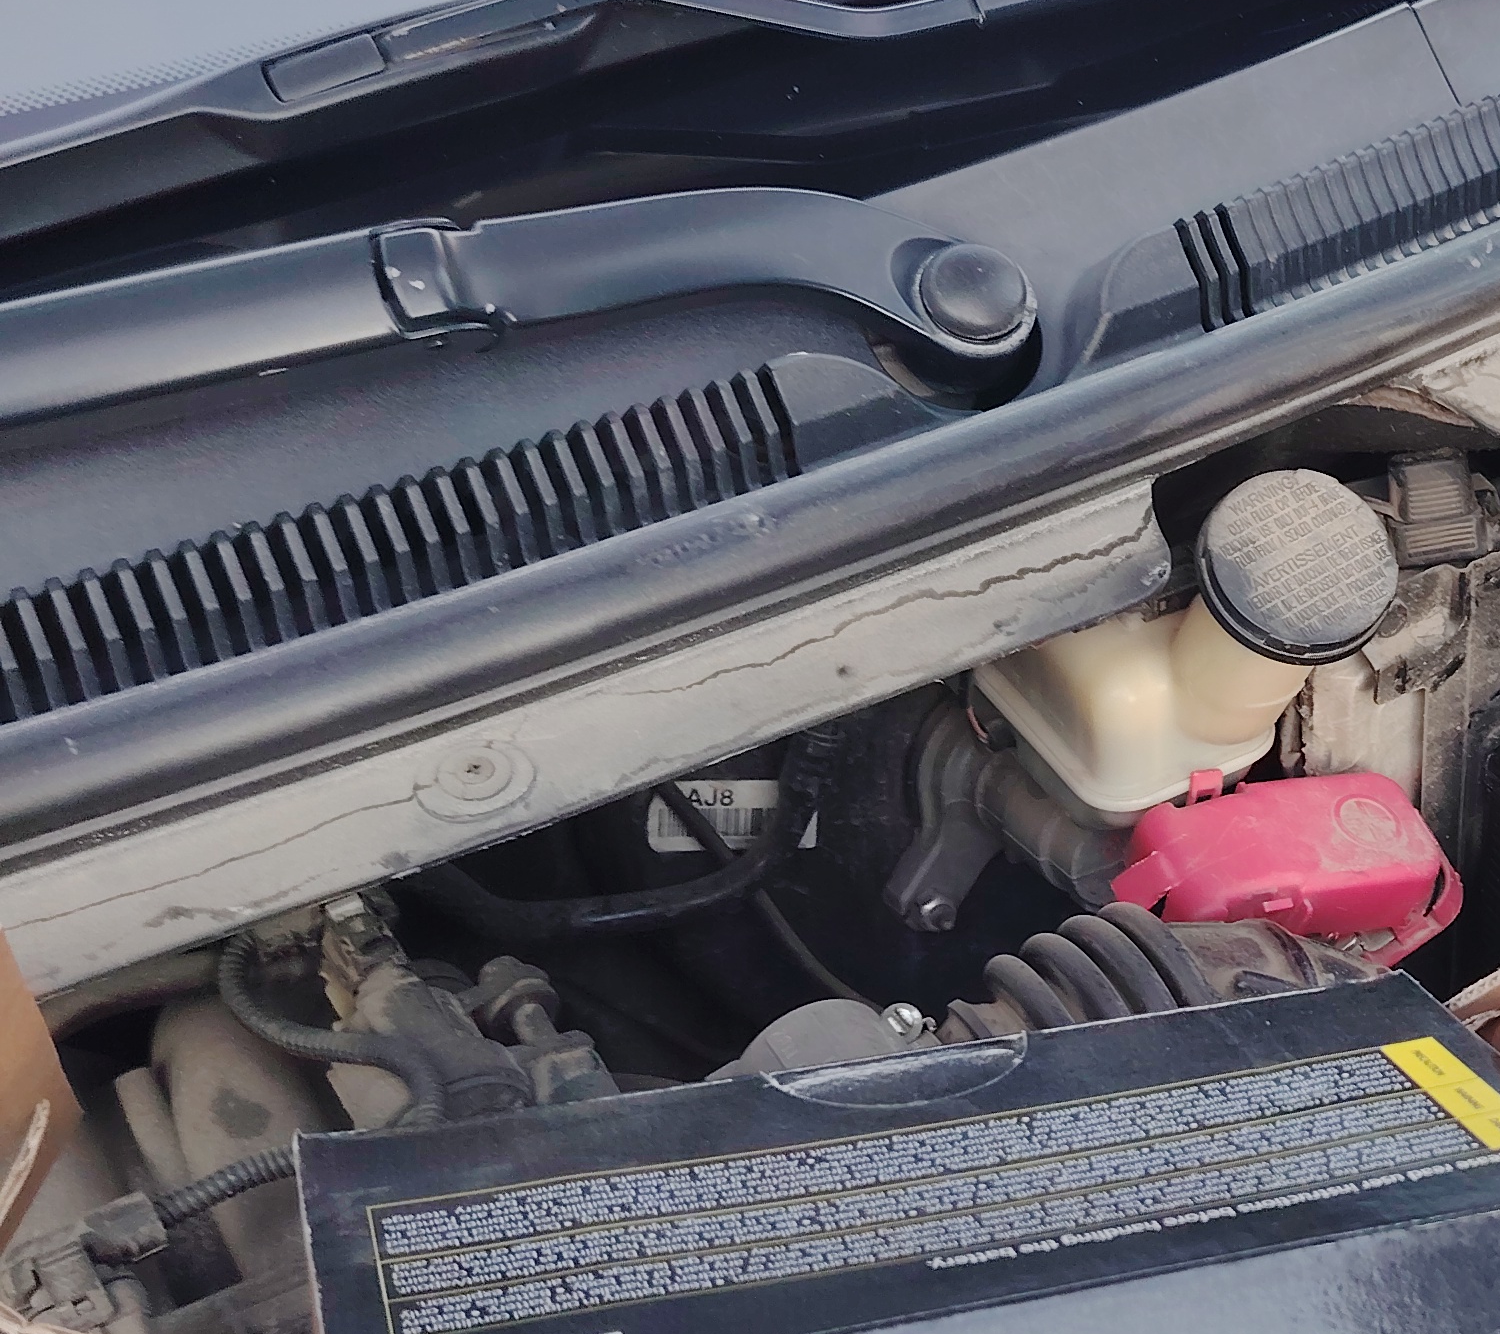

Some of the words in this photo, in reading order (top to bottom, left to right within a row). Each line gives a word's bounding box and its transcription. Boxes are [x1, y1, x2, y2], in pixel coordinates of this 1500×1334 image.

[1361, 1174, 1406, 1191] user
[1407, 1163, 1454, 1182] read
[1237, 1183, 1360, 1213] instructions
[1162, 1206, 1237, 1228] before
[1060, 1219, 1162, 1247] handling
[1018, 1238, 1059, 1254] the
